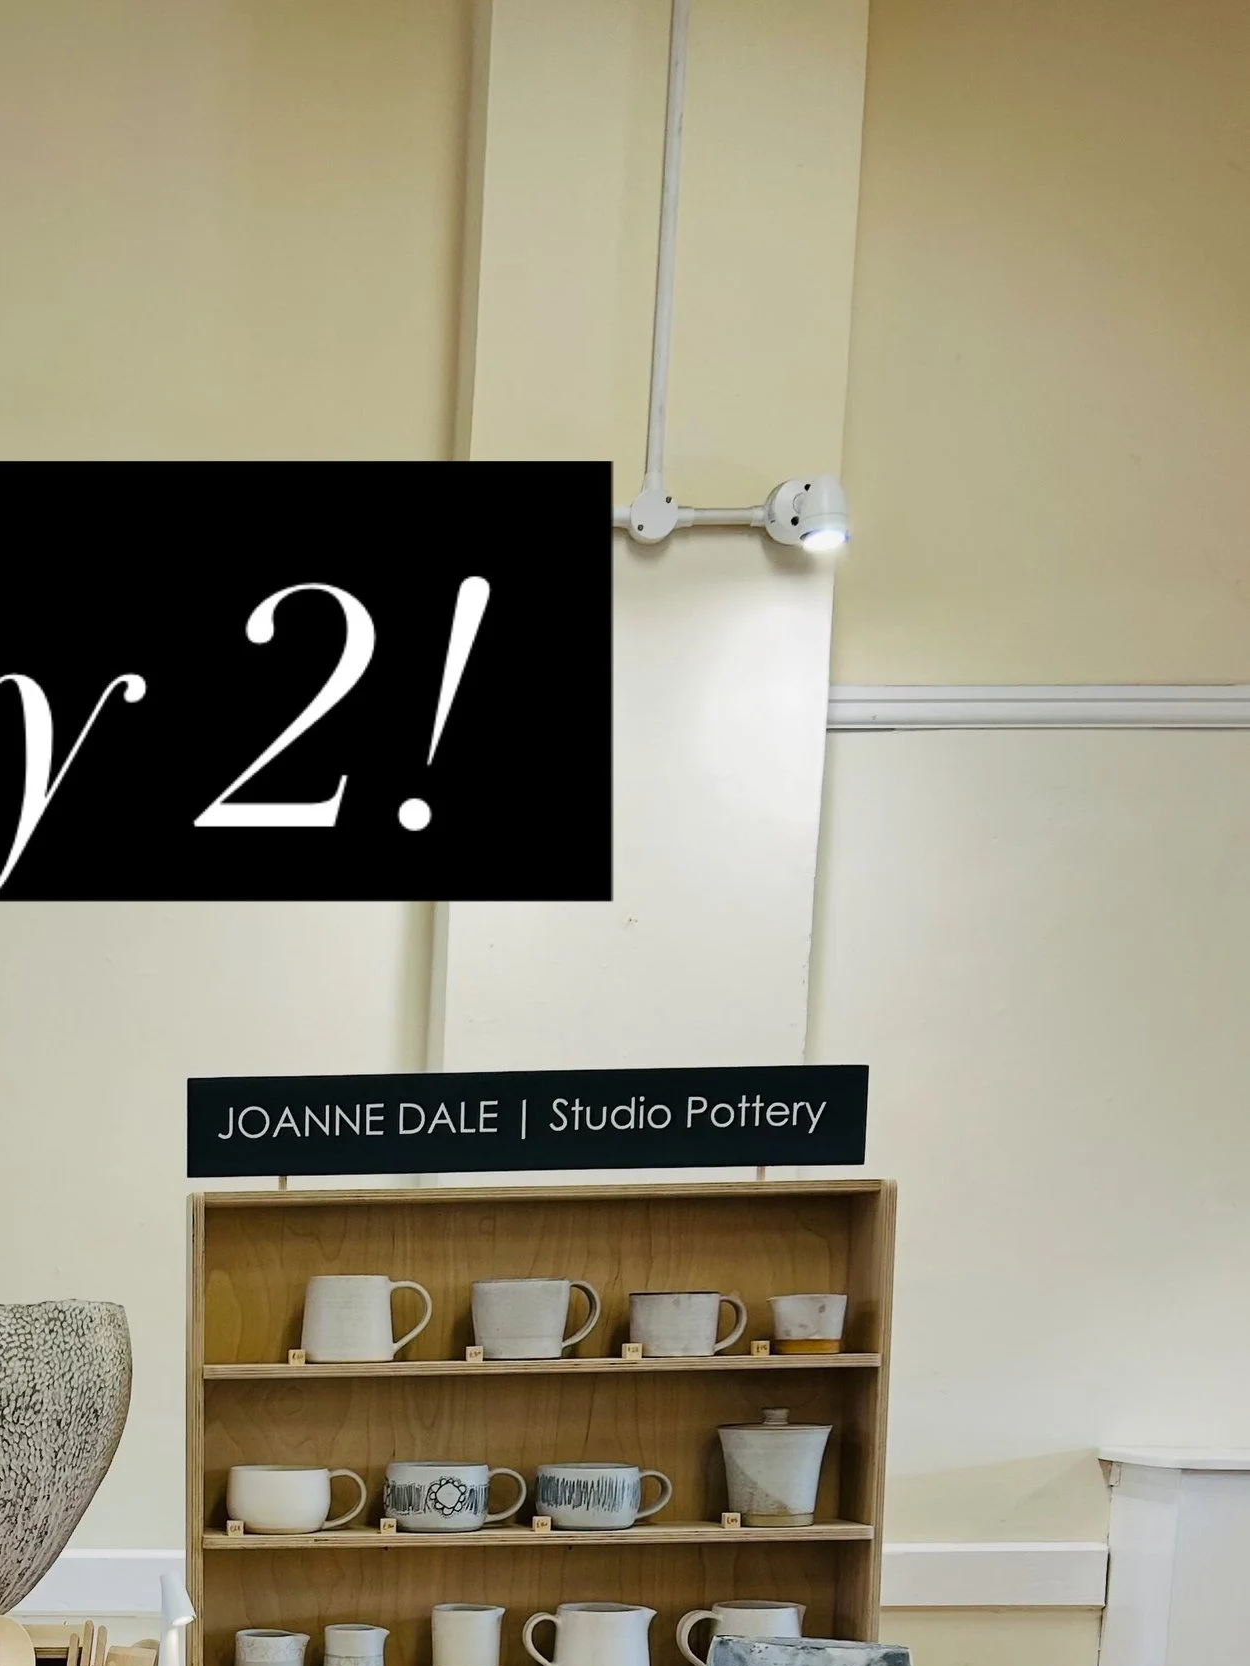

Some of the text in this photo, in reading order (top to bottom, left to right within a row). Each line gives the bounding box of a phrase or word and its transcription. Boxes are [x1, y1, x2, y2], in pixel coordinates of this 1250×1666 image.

[217, 1103, 385, 1140] JOANNE
[399, 1101, 499, 1135] DALE
[549, 1096, 672, 1132] Studio
[686, 1094, 827, 1134] Pottery
